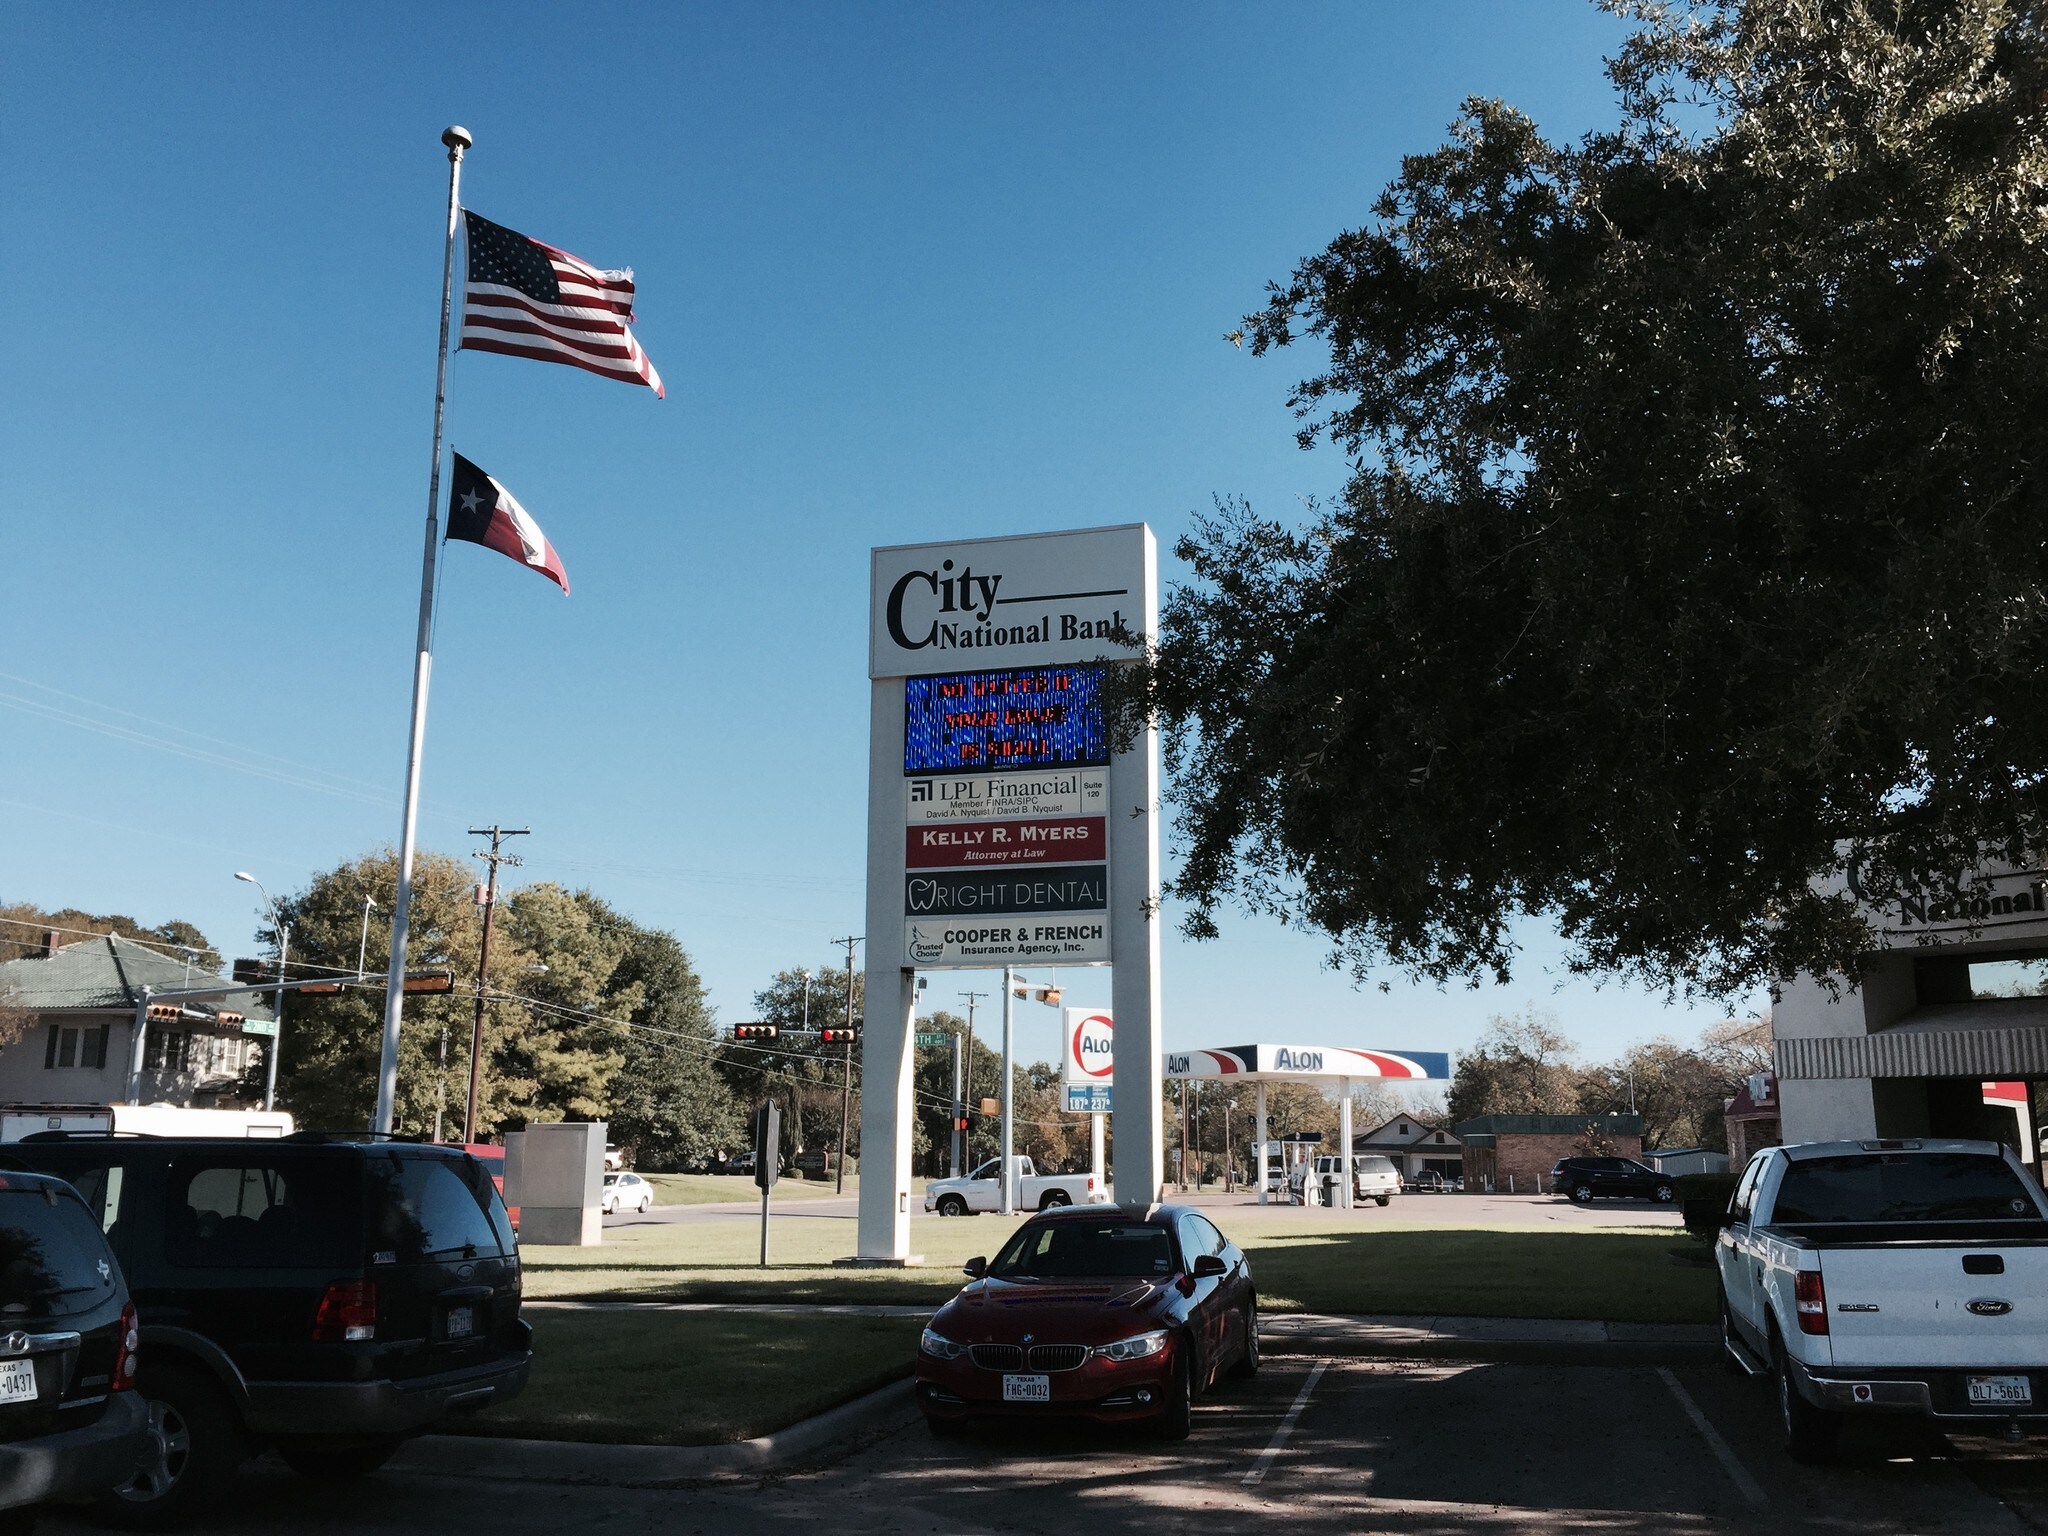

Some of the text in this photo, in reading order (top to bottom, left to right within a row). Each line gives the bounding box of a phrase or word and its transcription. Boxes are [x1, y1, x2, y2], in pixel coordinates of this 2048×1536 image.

[887, 559, 1002, 650] City
[939, 610, 1128, 650] National Bank
[940, 776, 1077, 801] LPL Financial
[1083, 781, 1103, 790] Suite
[926, 810, 949, 819] David
[960, 807, 990, 818] Nyquist
[997, 807, 1020, 816] David
[1032, 804, 1063, 815] Nyquist
[950, 797, 1039, 809] Member FINRA/SIPC
[922, 826, 1089, 846] KELLY R. MYERS
[964, 849, 1046, 861] Attorney at Law
[908, 878, 1104, 911] WRIGHT DENTAL
[944, 925, 1103, 944] COOPER & FRENCH
[916, 942, 944, 951] Trusted
[961, 942, 1085, 955] Insurance Agency, Inc.
[1168, 1055, 1190, 1074] ALON
[1278, 1047, 1323, 1069] ALON
